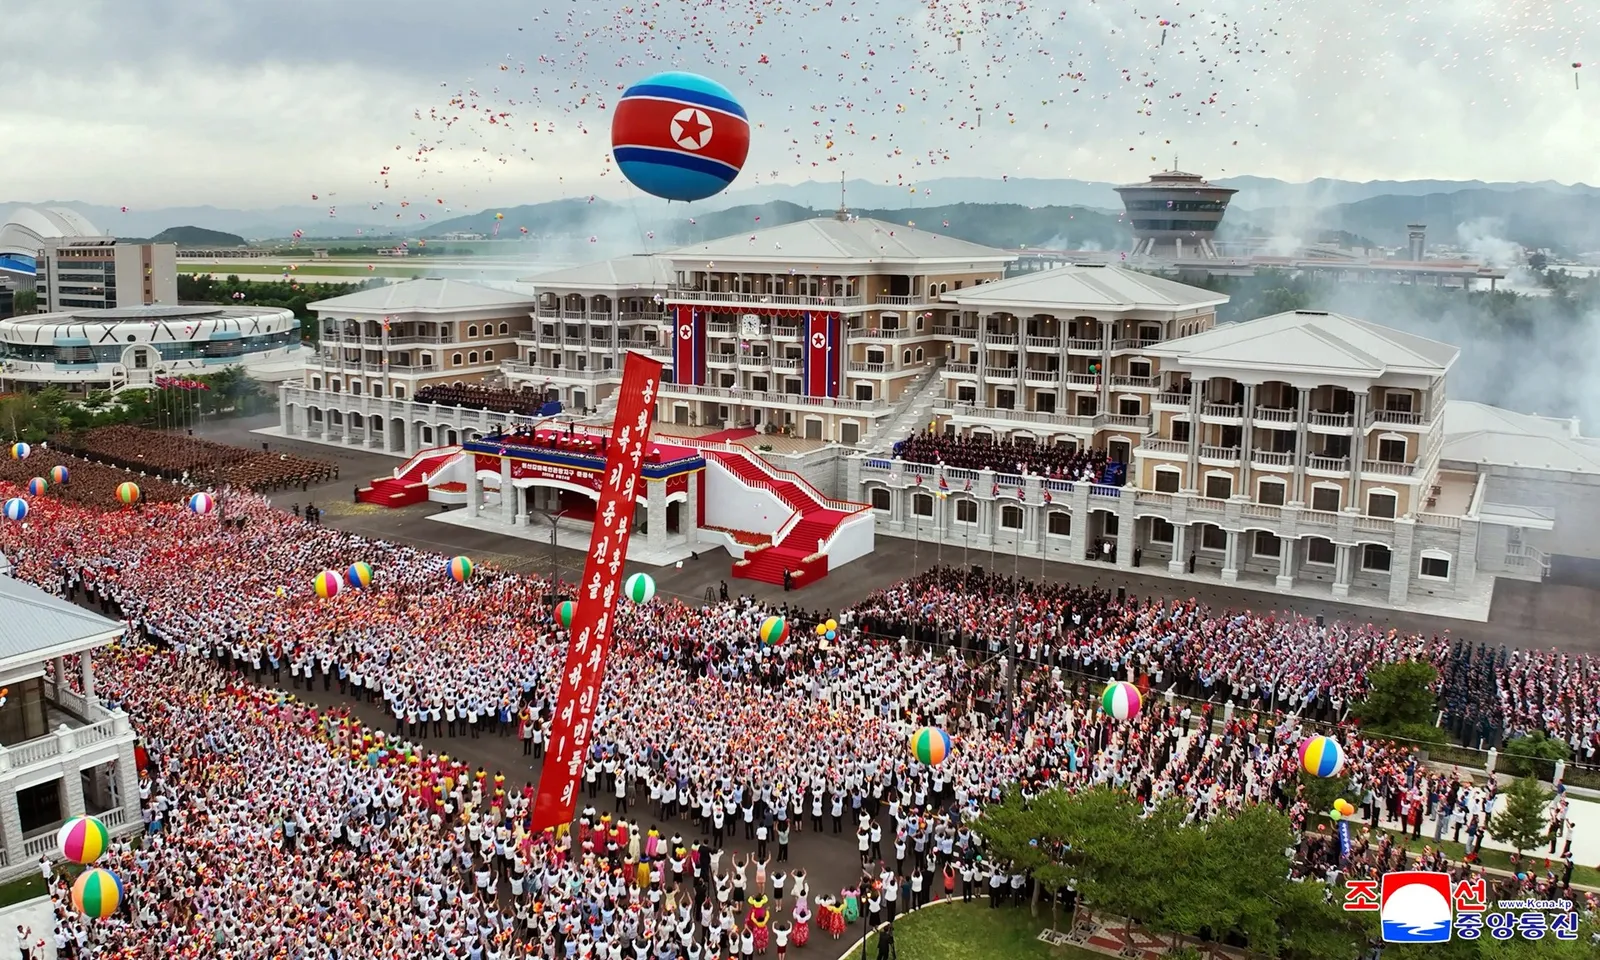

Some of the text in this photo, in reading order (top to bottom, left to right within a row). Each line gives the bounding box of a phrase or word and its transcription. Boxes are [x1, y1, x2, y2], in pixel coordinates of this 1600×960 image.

[557, 425, 631, 762] 복리증진을 위하여!
[560, 378, 654, 807] 공화국의 부흥발전과 인민들의
